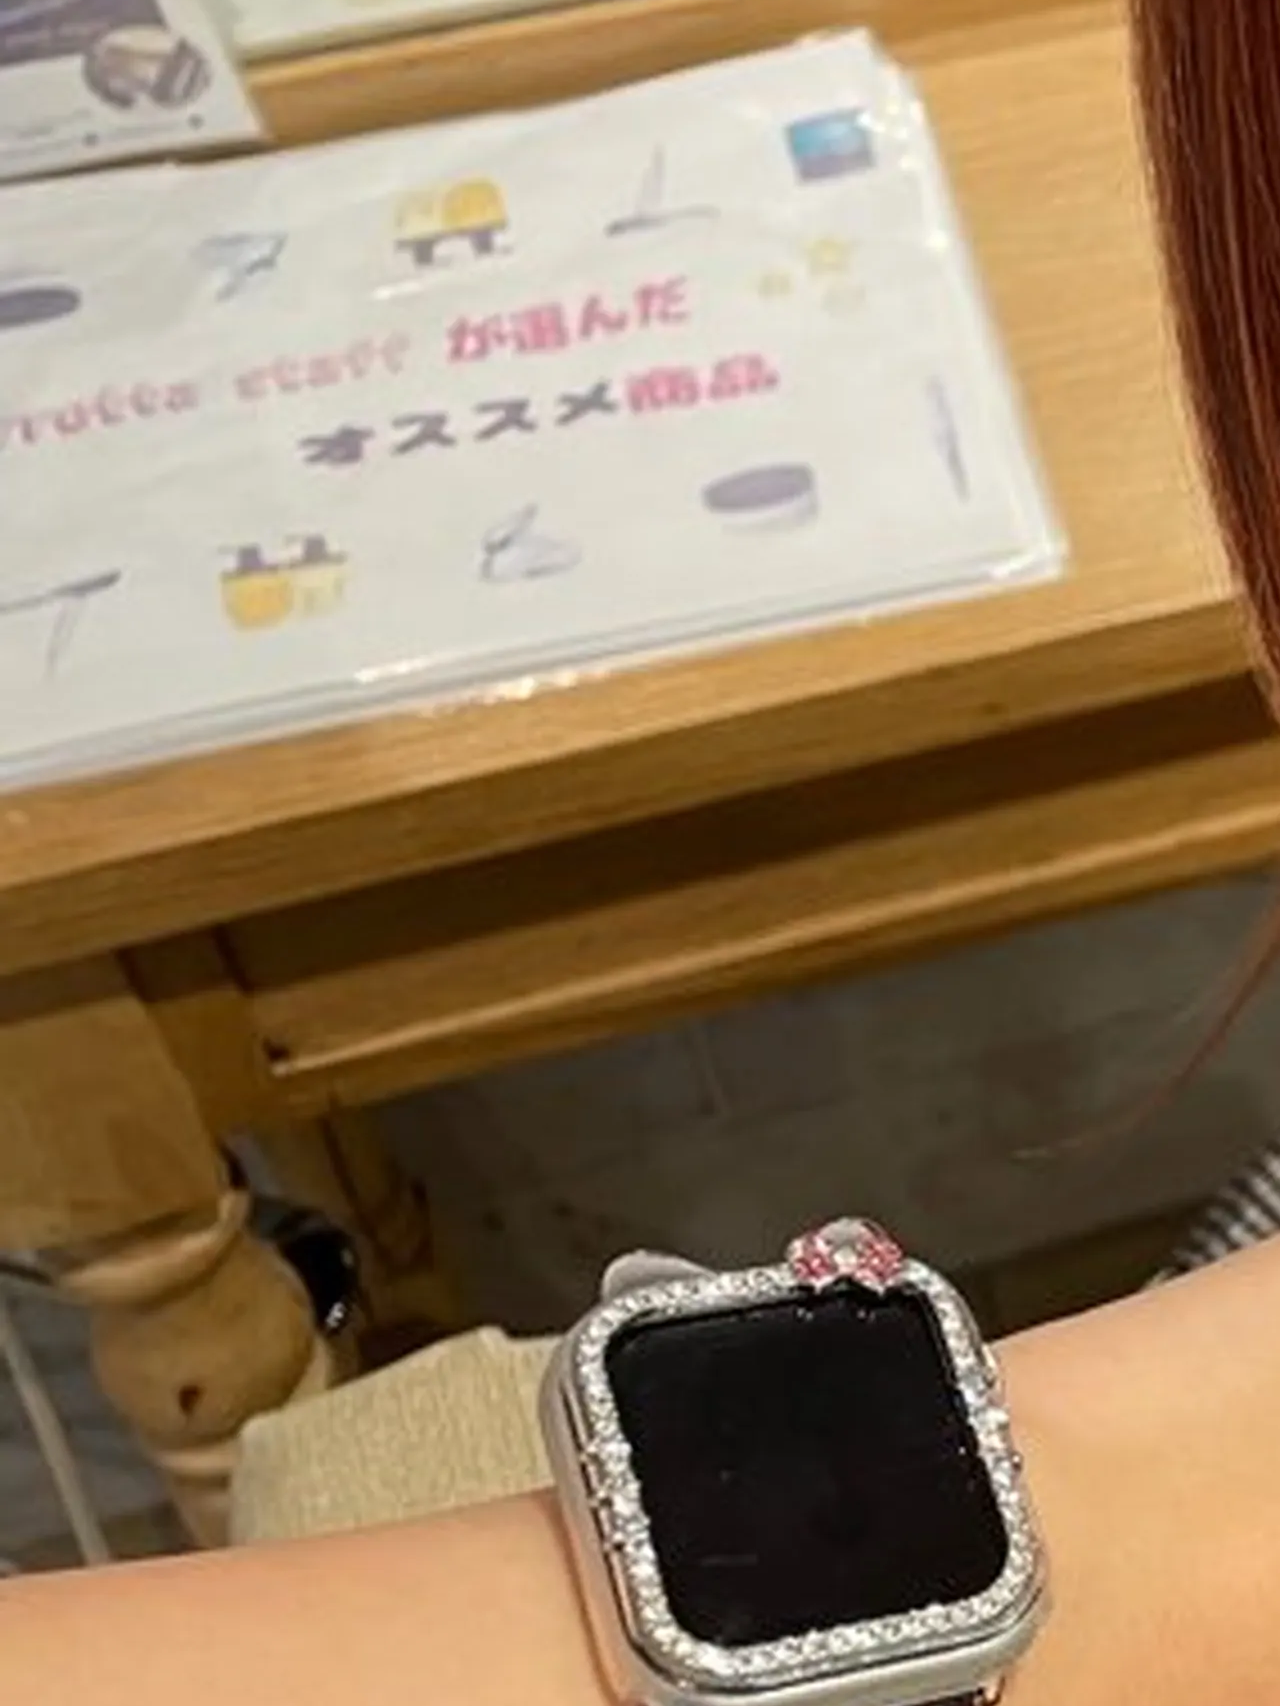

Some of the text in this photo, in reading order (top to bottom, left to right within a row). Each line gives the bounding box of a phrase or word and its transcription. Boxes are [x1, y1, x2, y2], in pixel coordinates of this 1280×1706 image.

[298, 352, 780, 465] オススメ商品
